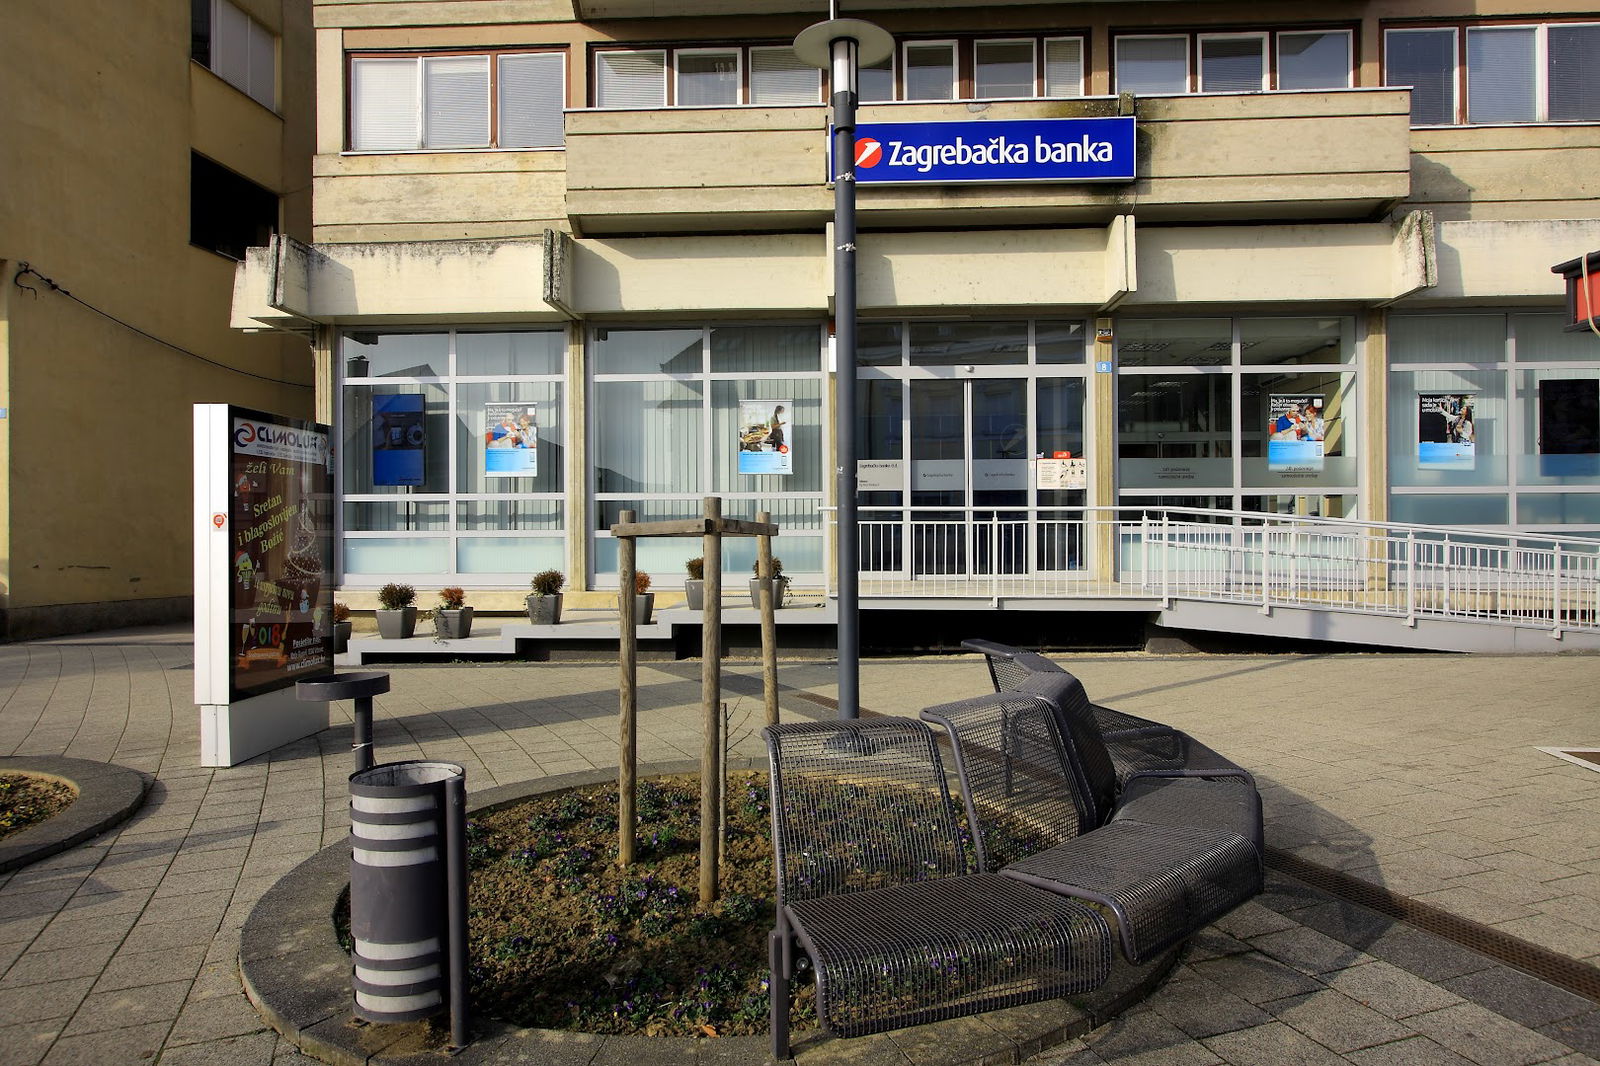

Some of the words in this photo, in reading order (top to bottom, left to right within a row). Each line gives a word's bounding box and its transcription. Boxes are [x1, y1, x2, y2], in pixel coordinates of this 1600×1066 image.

[888, 137, 1029, 172] Zagrebačka
[1035, 135, 1113, 163] banka
[257, 426, 317, 449] CLIMOLUX
[246, 461, 267, 474] želi
[270, 463, 295, 475] Vam
[253, 494, 282, 517] Sretan
